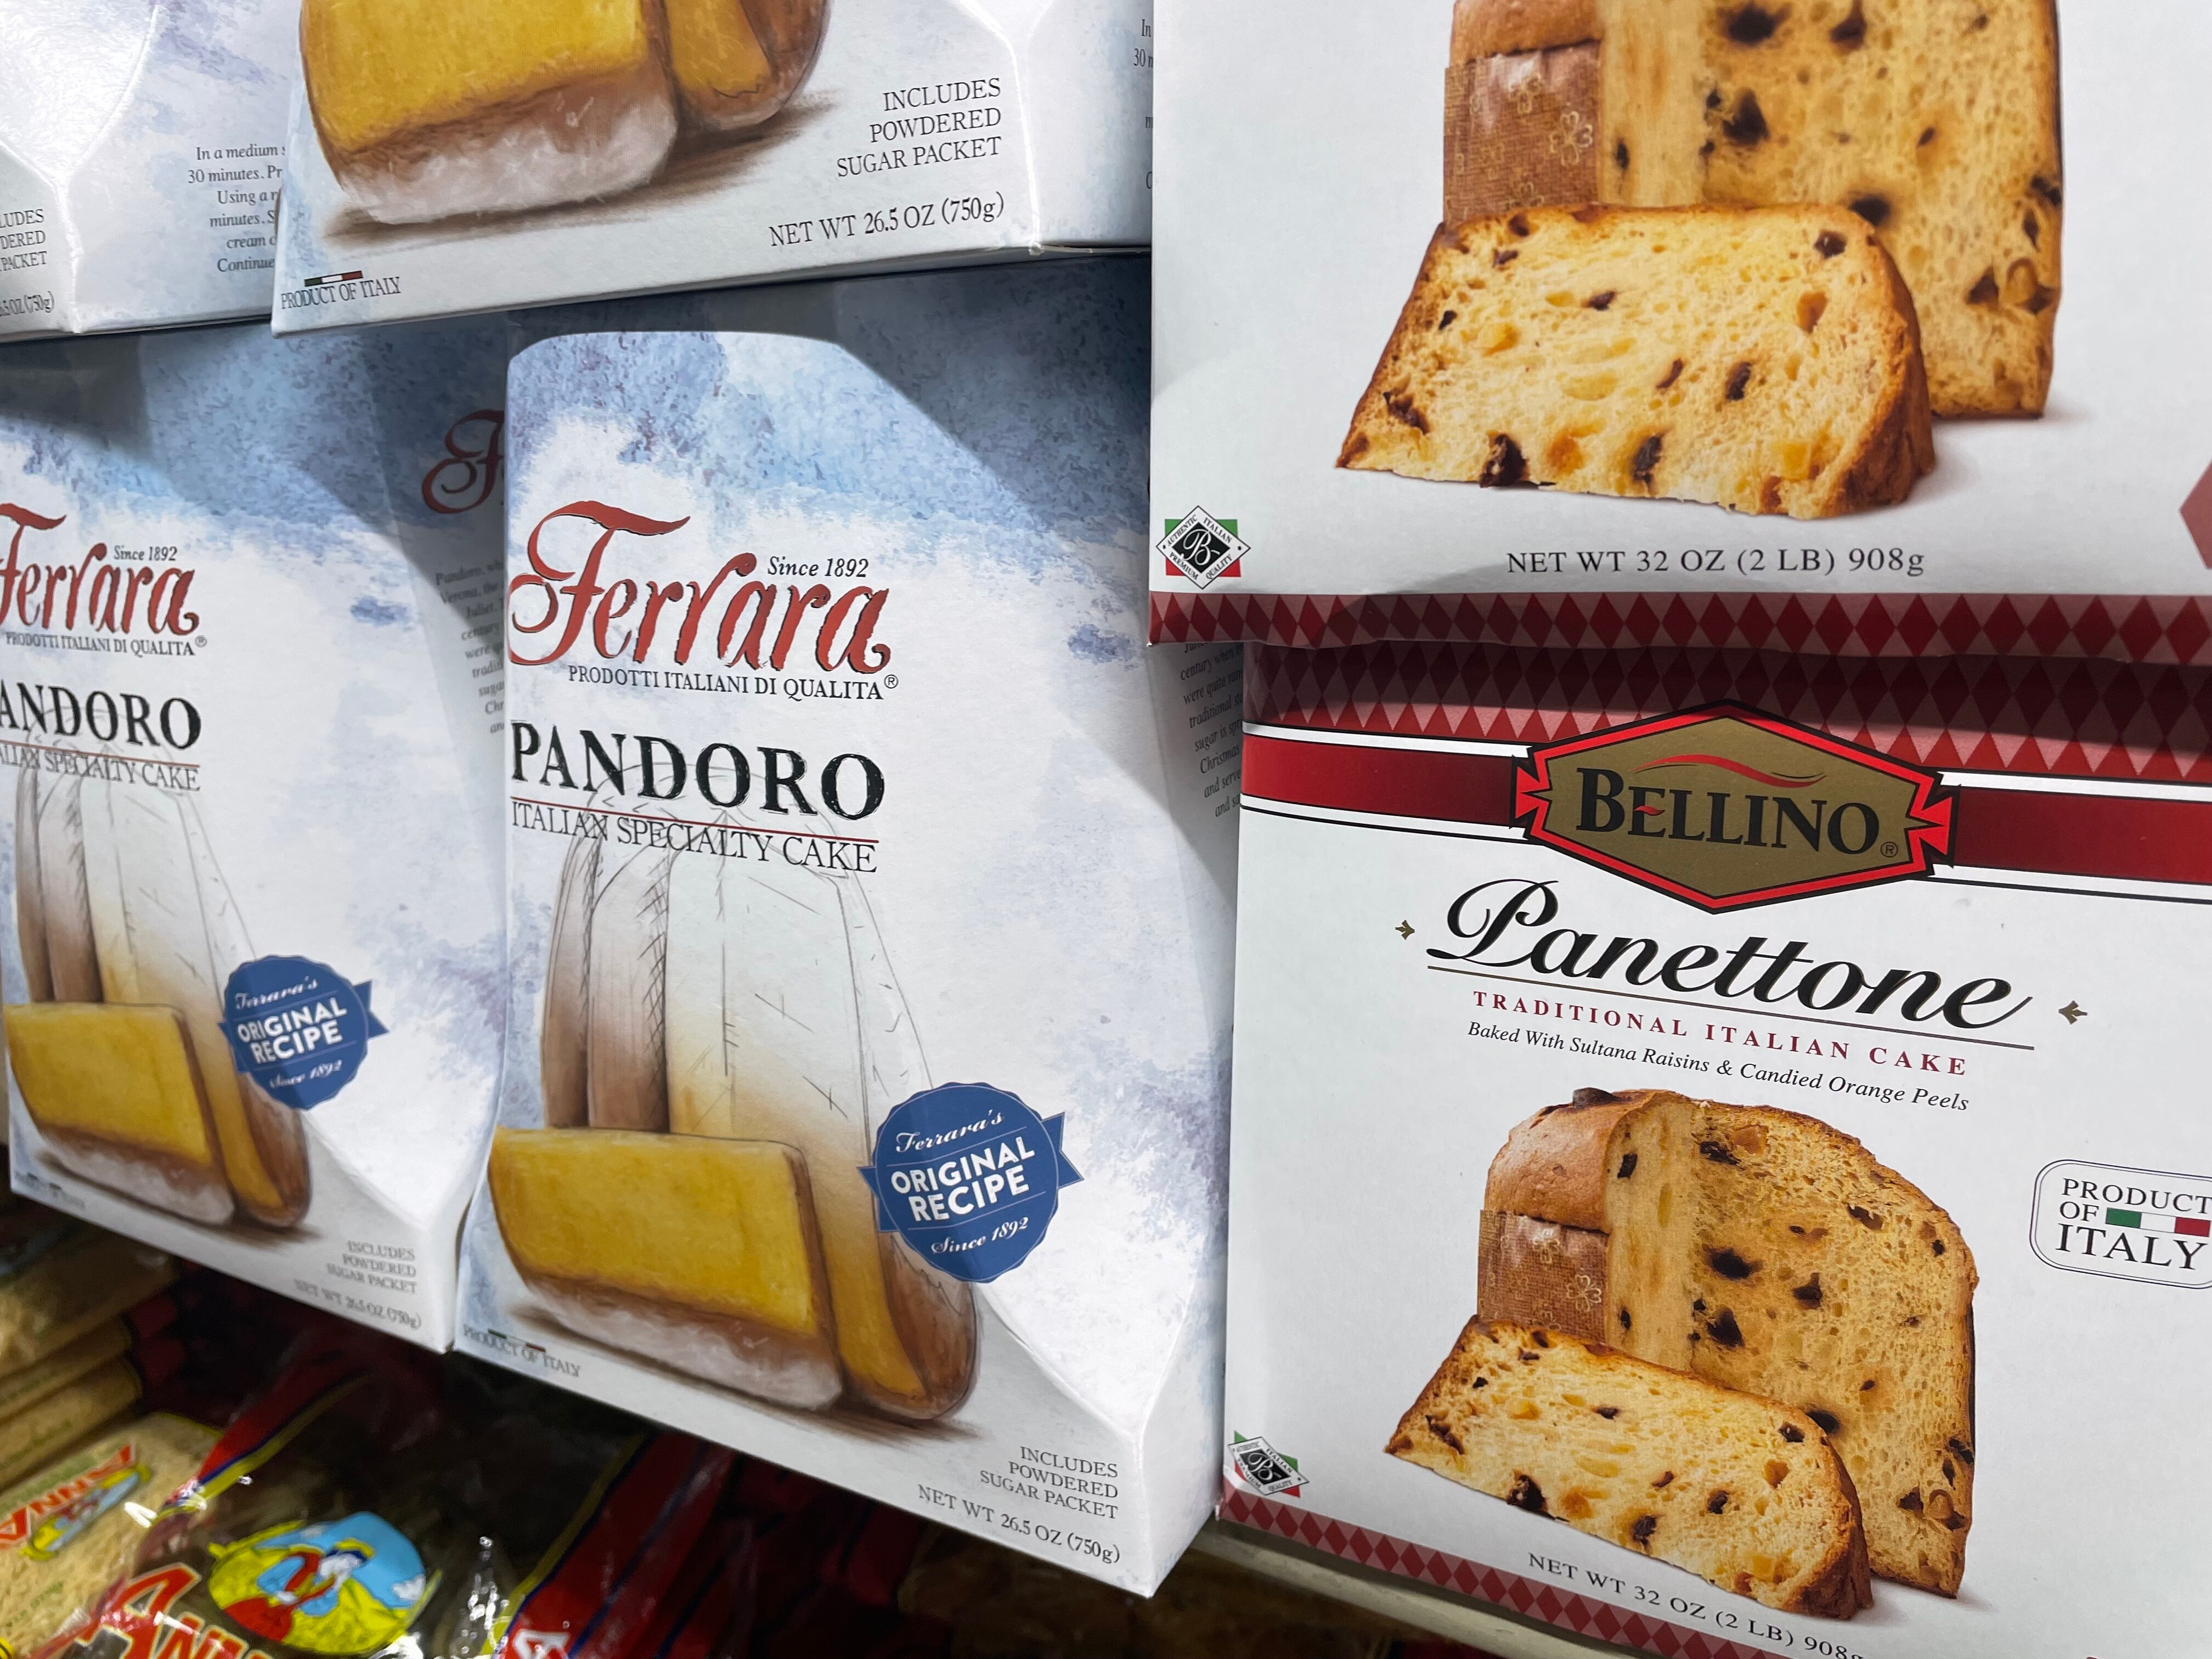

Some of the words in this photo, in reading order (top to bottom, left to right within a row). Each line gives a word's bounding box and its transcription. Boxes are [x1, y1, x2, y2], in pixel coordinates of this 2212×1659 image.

[883, 77, 1001, 112] INCLUDES
[870, 107, 1002, 143] POWDERED
[196, 147, 210, 160] In
[214, 149, 223, 159] a
[225, 144, 278, 157] medium
[837, 149, 907, 178] SUGAR
[912, 136, 1002, 167] PACKET
[188, 169, 205, 183] 30
[207, 168, 264, 182] minutes.
[217, 190, 256, 206] Using
[210, 213, 265, 228] minutes.
[769, 220, 813, 247] NET
[819, 214, 858, 241] WT
[864, 208, 898, 235] 26.5
[903, 203, 935, 229] OZ
[941, 191, 1005, 225] (750g)
[227, 236, 266, 249] cream
[280, 285, 337, 309] PRODUCT
[338, 283, 357, 301] OF
[359, 276, 401, 298] ITALY
[1167, 514, 1198, 546] AUTHENTIC
[1204, 517, 1232, 544] ITALIAN
[113, 545, 144, 561] Since
[148, 546, 178, 562] 1892
[768, 556, 818, 577] Since
[823, 558, 870, 578] 1892
[1170, 551, 1198, 580] PREMIUM
[1206, 554, 1233, 579] QUALITY
[1507, 552, 1567, 573] NET
[1576, 551, 1626, 573] WT
[1637, 550, 1669, 573] 32
[1680, 549, 1725, 572] OZ
[1737, 549, 1766, 575] (2
[1778, 549, 1835, 575] LB)
[1848, 548, 1926, 577] 908g
[508, 500, 891, 674] Ferrara
[5, 631, 60, 649] PRODOTTI
[61, 635, 110, 652] ITALIANI
[114, 639, 127, 653] DI
[568, 665, 659, 687] PRODOTTI
[663, 672, 748, 693] ITALIANI
[754, 676, 777, 695] DI
[1194, 731, 1217, 752] sugar
[44, 749, 136, 784] SPECIALTY
[142, 763, 200, 791] CAKE
[510, 719, 885, 821] PANDORO
[1204, 776, 1220, 798] and
[1215, 796, 1230, 817] and
[1576, 767, 1880, 856] BELLINO
[512, 801, 608, 840] ITALIAN
[617, 817, 772, 862] SPECIALTY
[782, 837, 878, 873] CAKE
[1426, 878, 2033, 1029] Panettone
[237, 997, 347, 1043] ORIGINAL
[1473, 991, 1688, 1036] TRADITIONAL
[1706, 1024, 1849, 1059] ITALIAN
[1869, 1046, 1966, 1076] CAKE
[250, 1019, 343, 1064] RECIPE
[1468, 1022, 1521, 1042] Baked
[1526, 1030, 1565, 1049] With
[1570, 1037, 1637, 1061] Sultana
[1642, 1047, 1710, 1072] Raisins
[1717, 1060, 1733, 1075] &
[1740, 1063, 1824, 1089] Candied
[1829, 1076, 1905, 1103] Orange
[1911, 1087, 1970, 1111] Peels
[895, 1109, 1005, 1153] Ferrara's
[891, 1136, 1035, 1194] ORIGINAL
[908, 1165, 1029, 1222] RECIPE
[2059, 1201, 2100, 1222] OF
[2062, 1178, 2212, 1214] PRODUCT
[931, 1234, 986, 1255] Since
[991, 1216, 1029, 1241] 1892
[2055, 1223, 2209, 1270] ITALY
[1008, 1461, 1119, 1499] POWDERED
[1020, 1446, 1119, 1478] INCLUDES
[980, 1470, 1040, 1500] SUGAR
[1044, 1489, 1119, 1519] PACKET
[917, 1484, 957, 1510] NET
[962, 1499, 995, 1522] WT
[1001, 1514, 1031, 1535] 26.5
[1035, 1525, 1062, 1546] OZ
[1067, 1532, 1120, 1564] (750g)
[1528, 1552, 1578, 1579] NET
[1585, 1570, 1626, 1594] WT
[1634, 1585, 1661, 1607] 32
[1669, 1596, 1707, 1620] OZ
[1715, 1610, 1739, 1629] (2
[1747, 1619, 1795, 1648] LB)
